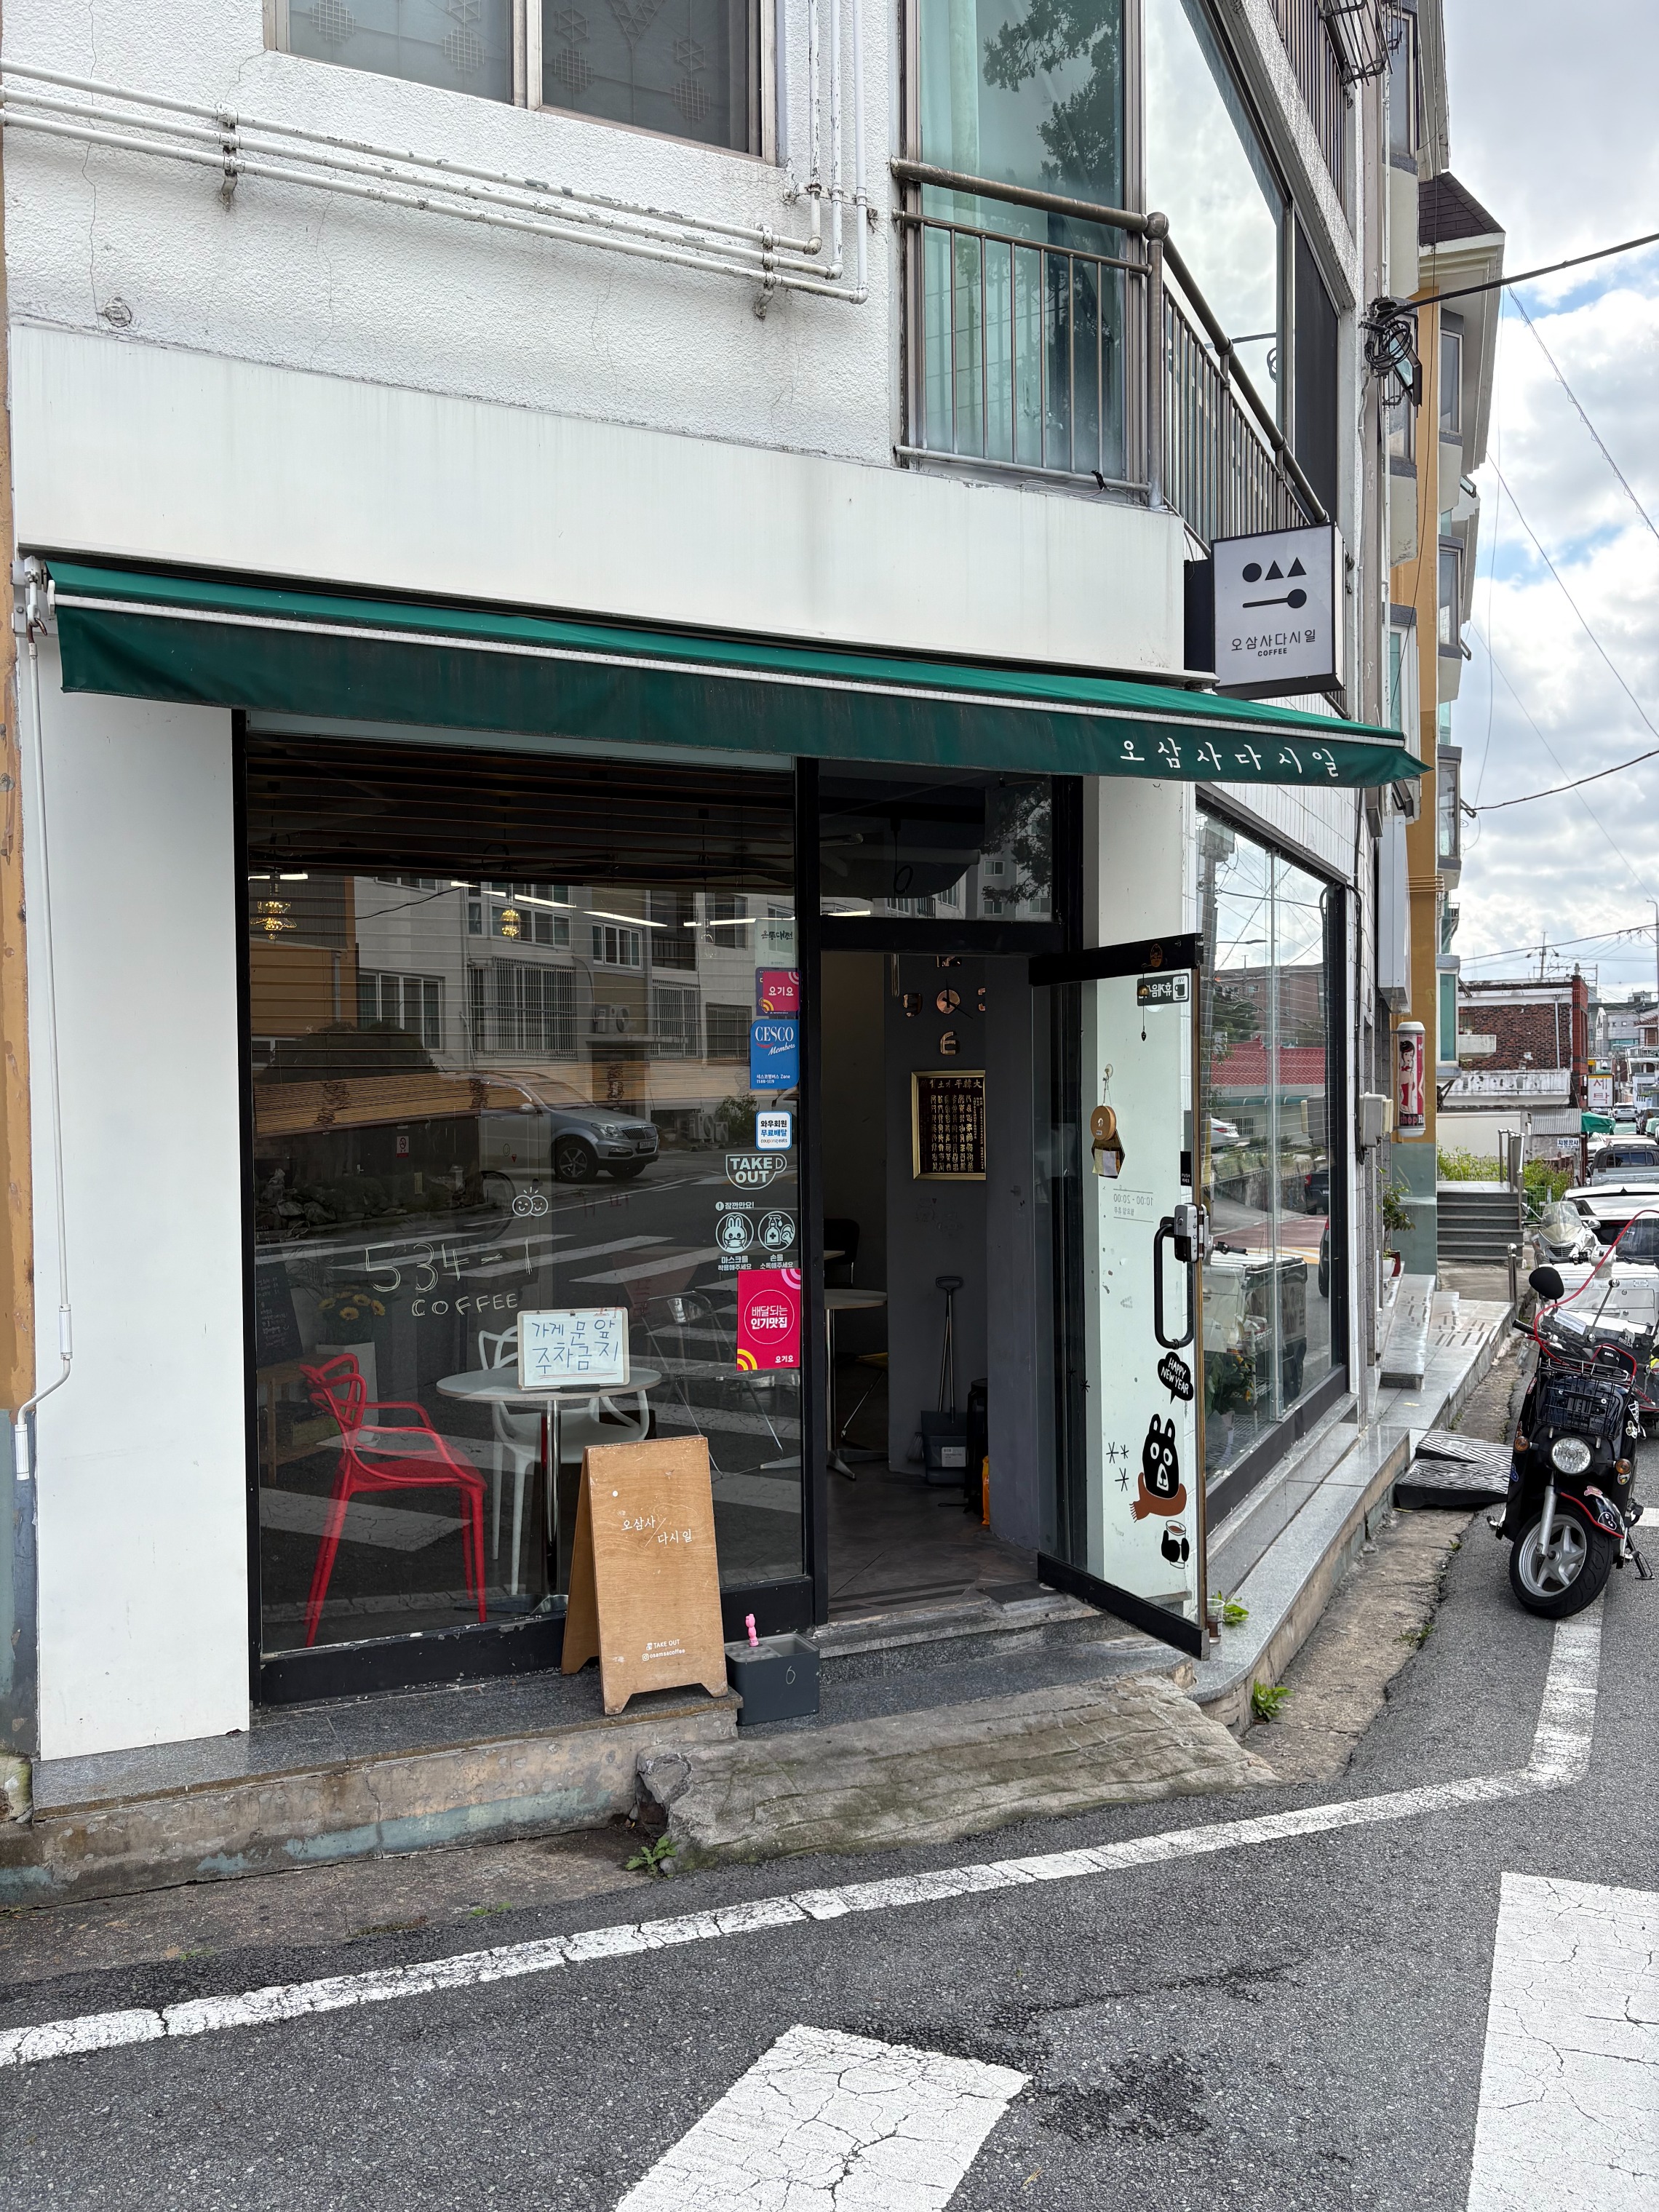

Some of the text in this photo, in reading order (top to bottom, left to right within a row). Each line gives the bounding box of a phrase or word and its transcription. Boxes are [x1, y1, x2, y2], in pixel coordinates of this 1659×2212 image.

[1231, 629, 1316, 651] 오삼사다시일
[1257, 647, 1288, 657] COFFEE
[768, 986, 794, 996] 요기요
[755, 1026, 795, 1043] CESCO
[768, 1043, 796, 1056] Members
[1593, 1078, 1610, 1105] 세탁
[760, 1120, 787, 1128] 와우회원
[760, 1129, 787, 1137] 무료배달
[730, 1158, 773, 1170] TAKE
[735, 1170, 770, 1184] OUT
[721, 1255, 749, 1263] 마스크를
[770, 1254, 784, 1262] 손을
[365, 1238, 533, 1292] 534-1
[411, 1293, 518, 1316] COFFEE
[751, 1305, 788, 1317] 배달되는
[532, 1322, 564, 1337] 가게
[750, 1317, 787, 1329] 인기맛집
[532, 1341, 618, 1374] 주차금지
[775, 1354, 794, 1364] 요기요
[1168, 1357, 1187, 1379] HAPPY
[1161, 1366, 1189, 1395] NEW YEAR
[621, 1516, 656, 1531] 오삼사
[658, 1529, 693, 1545] 다시일
[653, 1641, 667, 1649] TAKE
